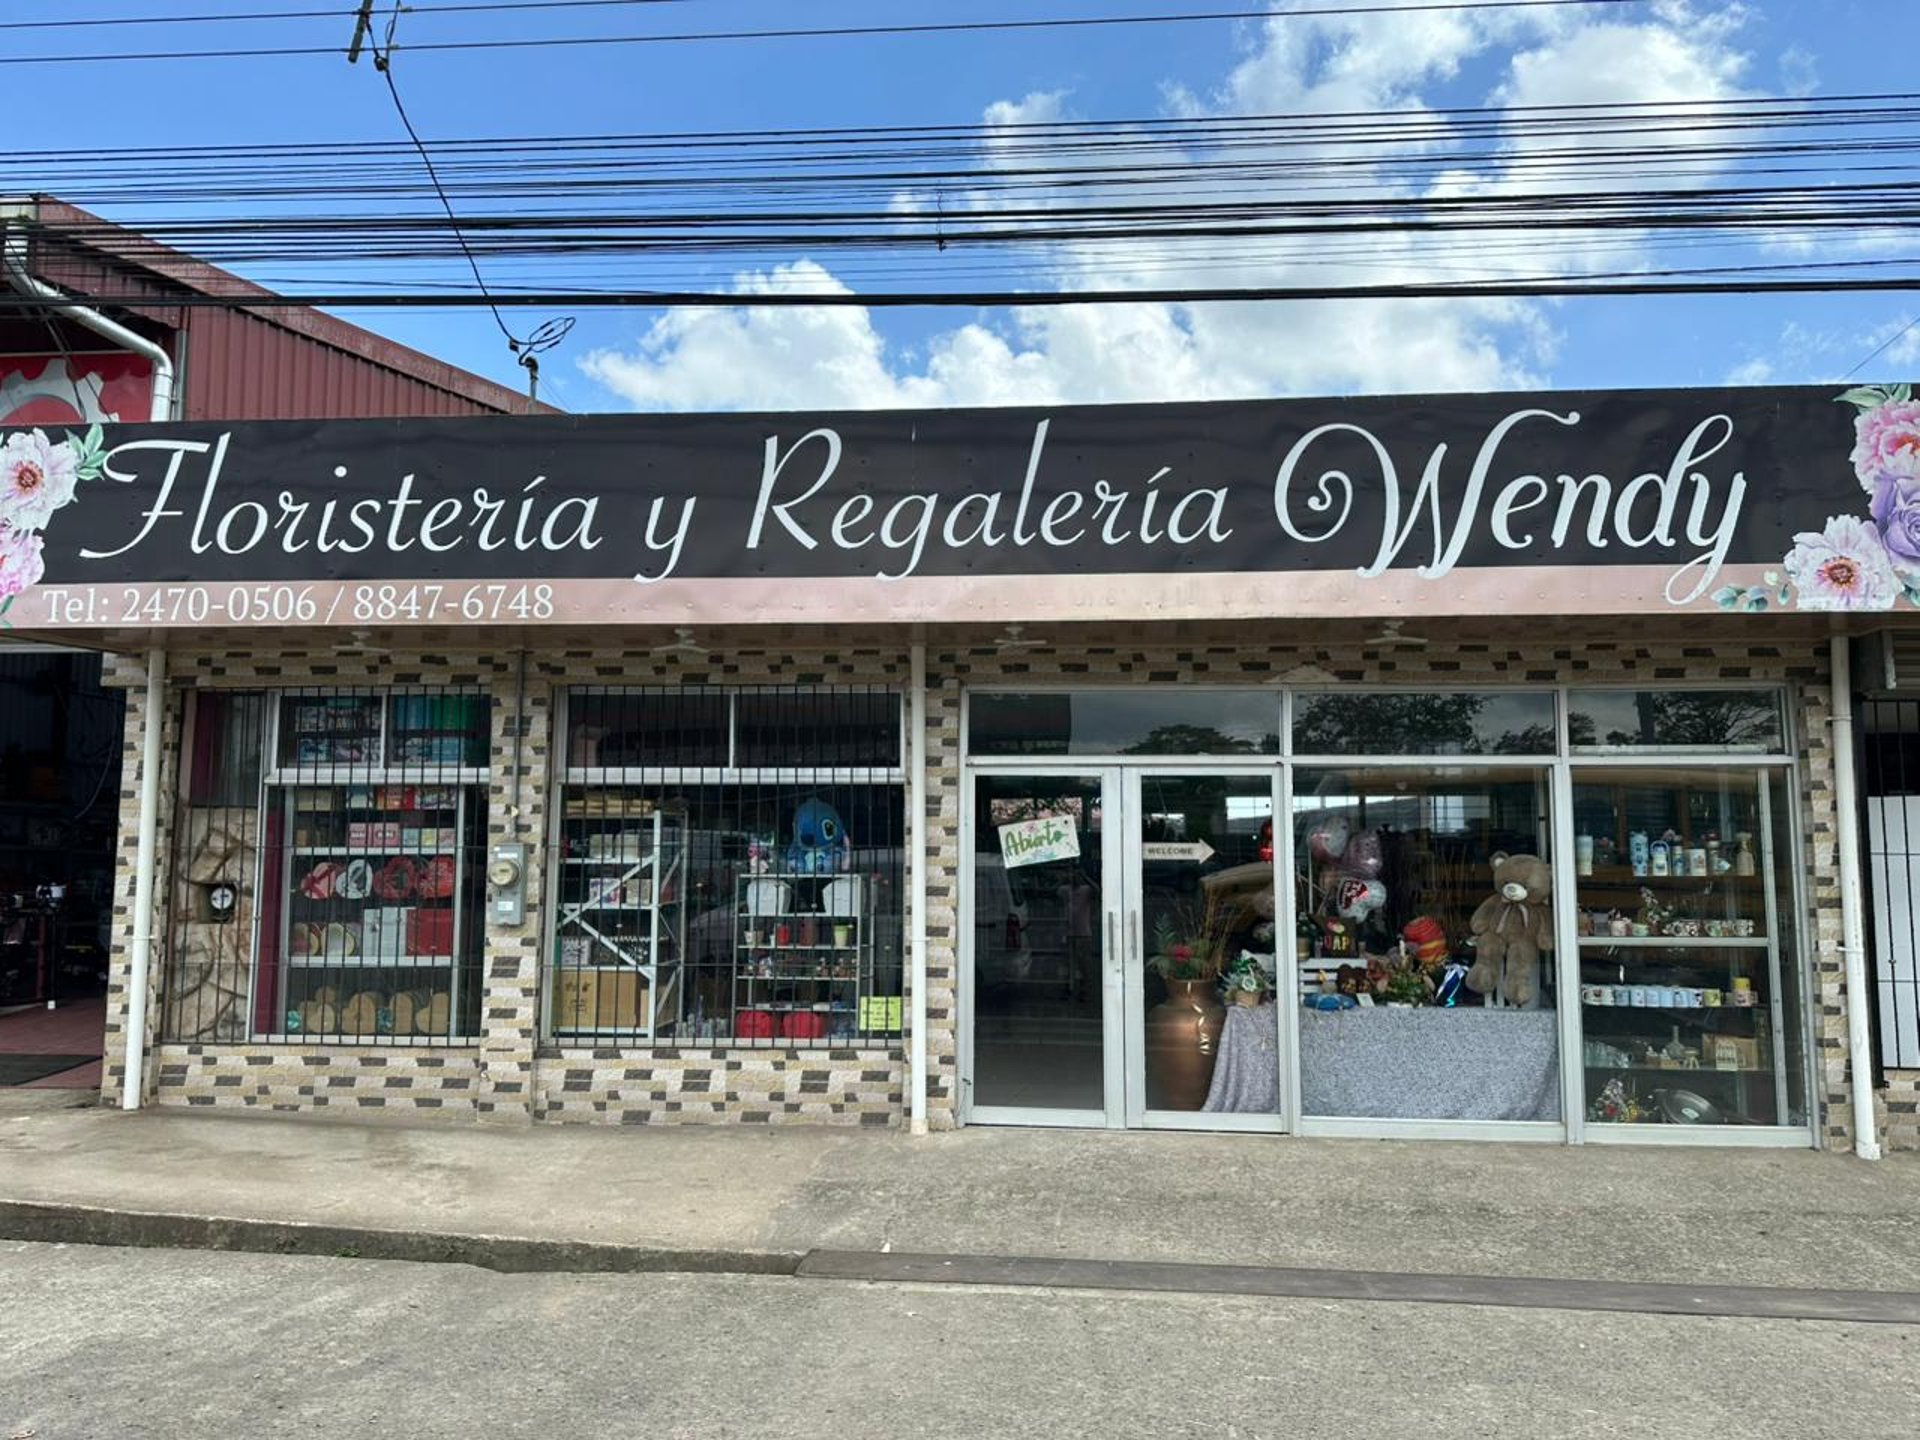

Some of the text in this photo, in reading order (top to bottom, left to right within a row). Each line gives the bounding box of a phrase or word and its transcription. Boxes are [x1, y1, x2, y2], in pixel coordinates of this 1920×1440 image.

[79, 408, 1747, 606] Floristería y Regalería Wendy
[43, 584, 555, 625] Tel: 2470-0506 / 8847-6748
[1147, 846, 1195, 856] WELCOME
